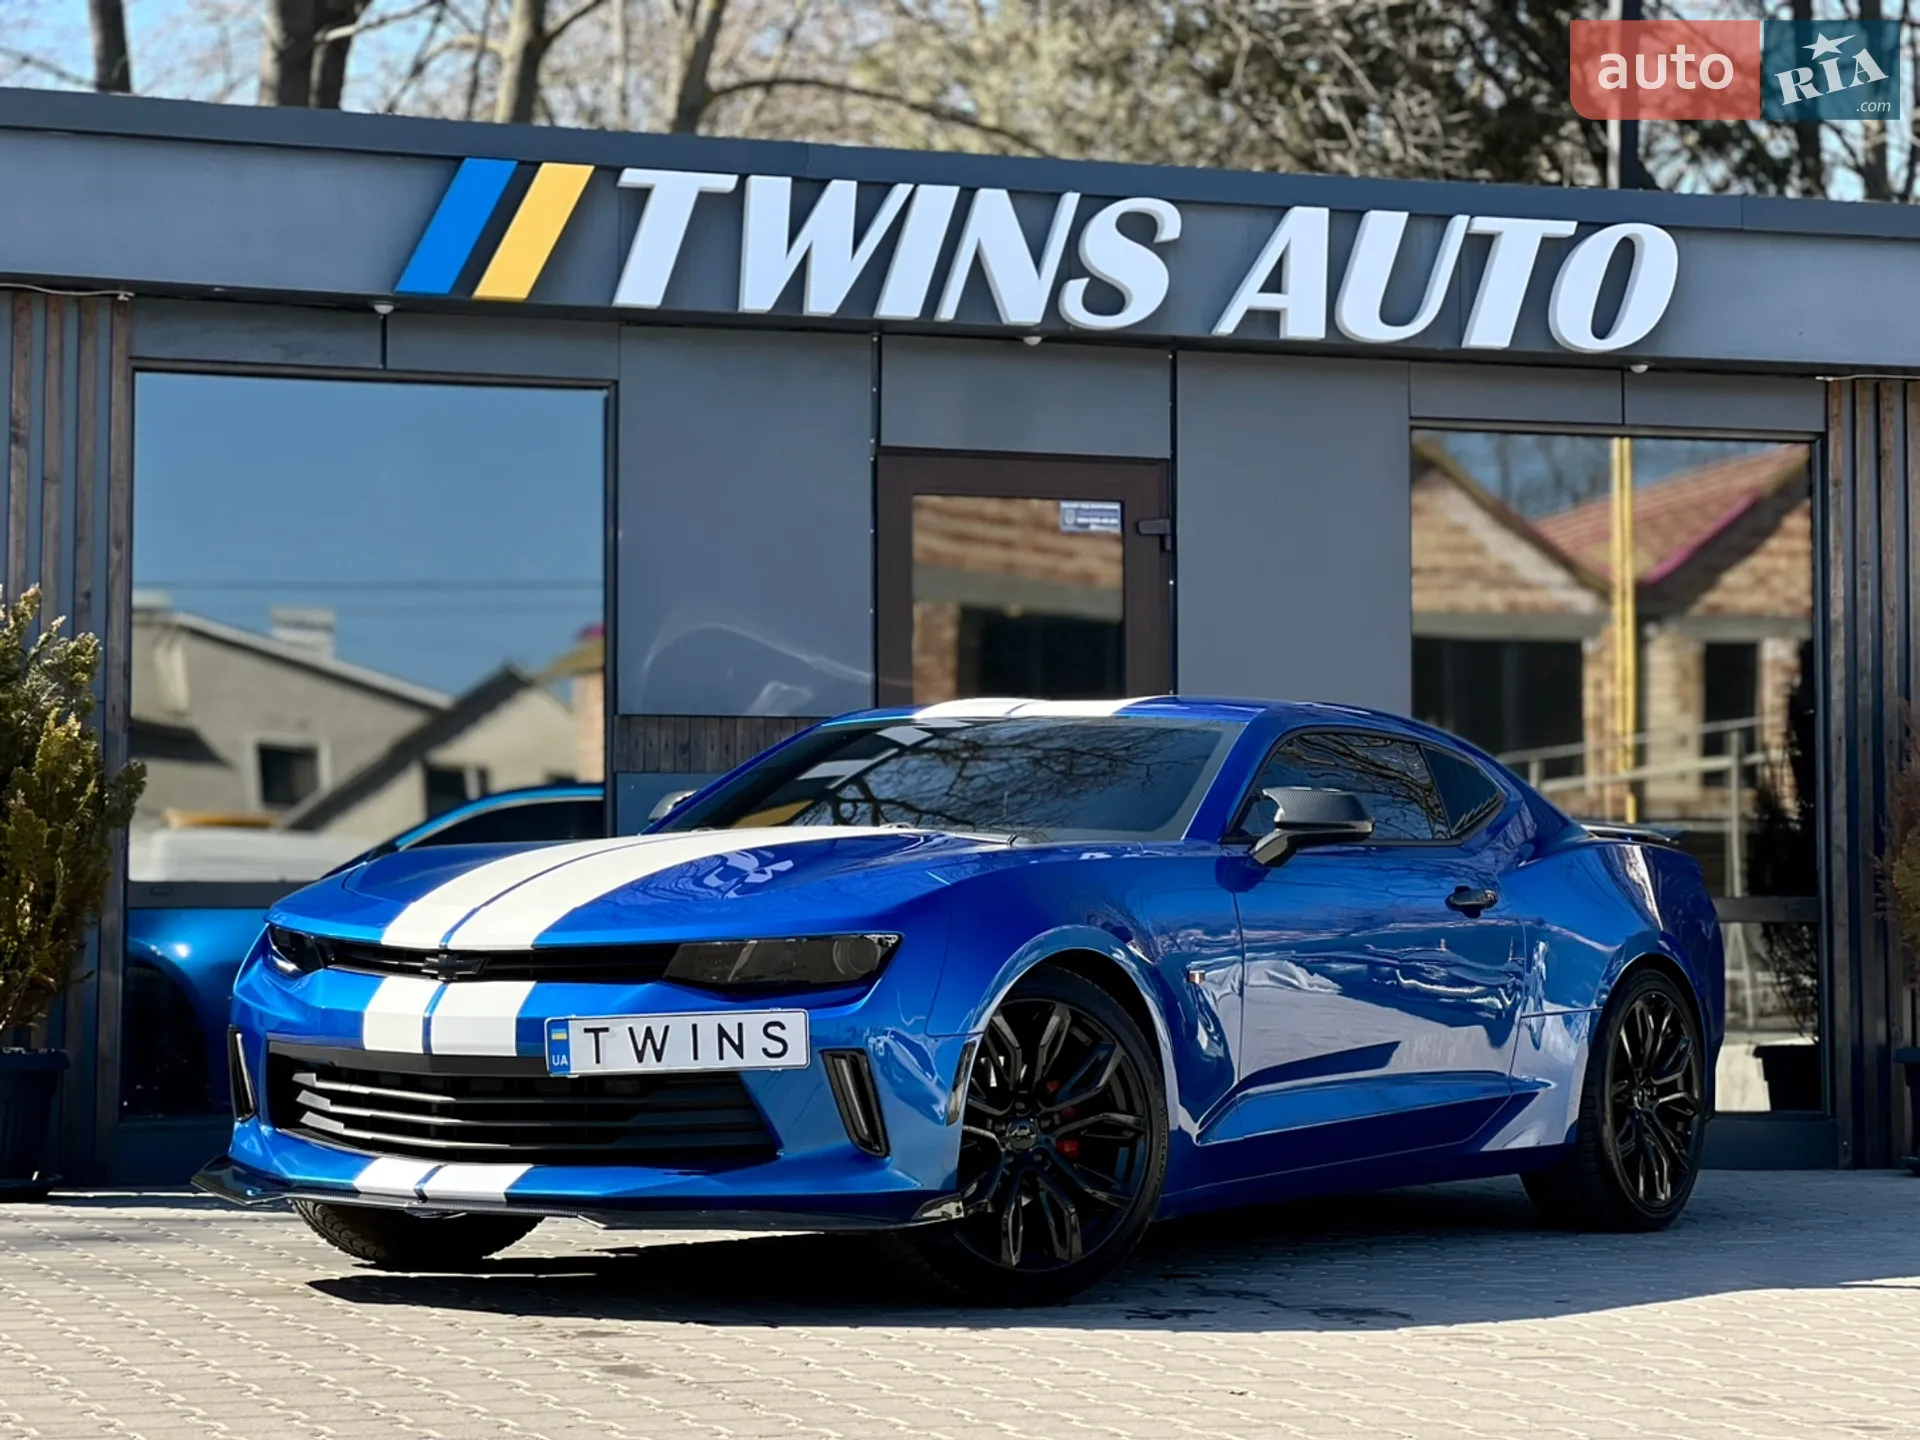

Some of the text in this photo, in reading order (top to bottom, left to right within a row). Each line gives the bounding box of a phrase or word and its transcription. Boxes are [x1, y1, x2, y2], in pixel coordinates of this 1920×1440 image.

[612, 168, 1678, 353] TWINS AUTO
[551, 1054, 569, 1066] UA
[583, 1021, 789, 1065] TWINS
